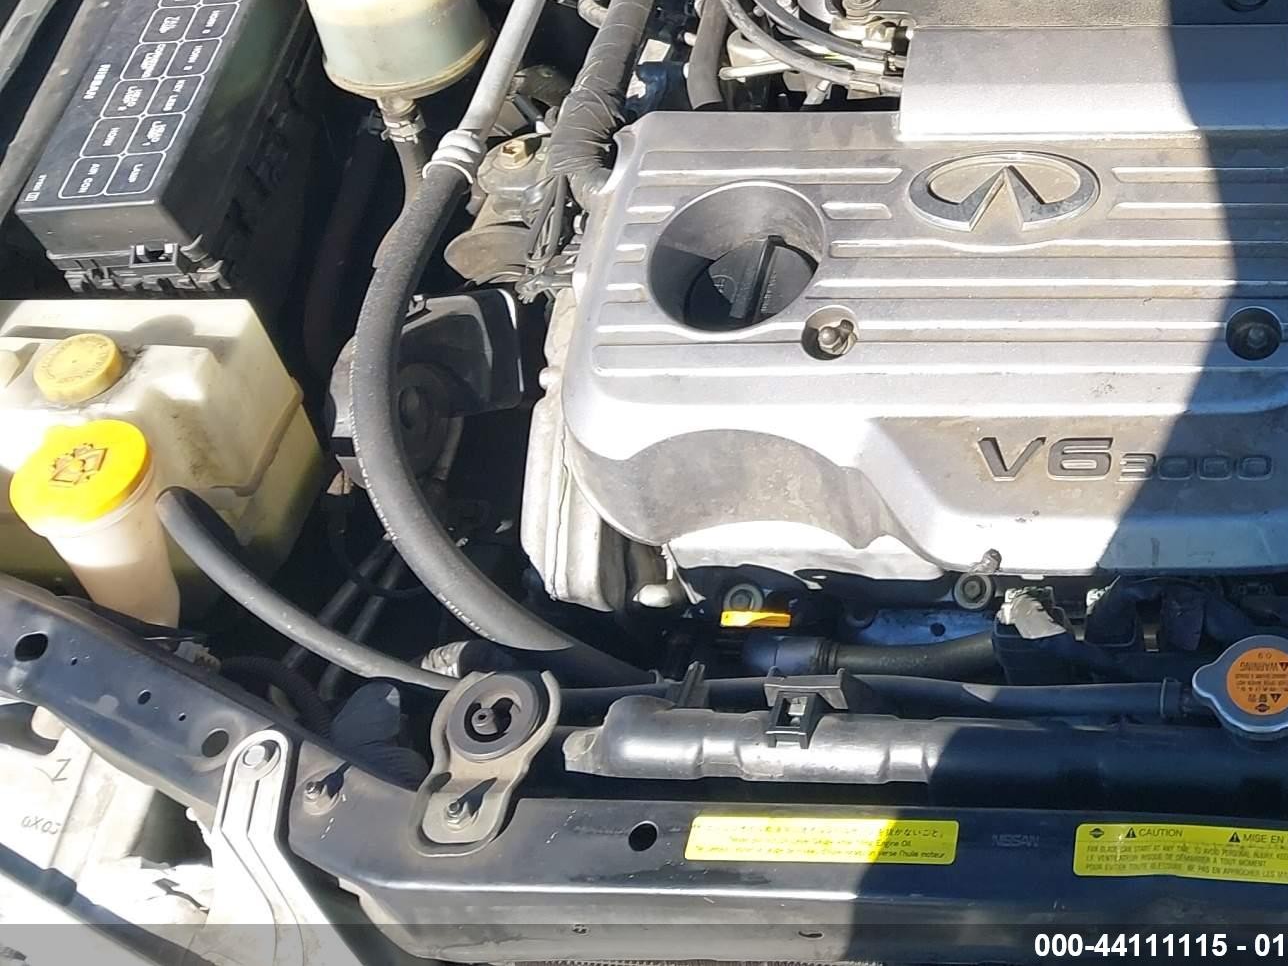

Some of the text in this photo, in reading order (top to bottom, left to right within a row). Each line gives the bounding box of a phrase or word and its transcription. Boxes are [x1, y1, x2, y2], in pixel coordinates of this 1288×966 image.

[82, 64, 112, 100] NISSAN
[128, 163, 144, 183] LAMP
[977, 436, 1114, 482] V6
[1116, 452, 1273, 483] 3000
[1240, 661, 1279, 671] WARNING
[1138, 828, 1184, 838] CAUTION
[1243, 833, 1268, 843] MISE
[1270, 835, 1284, 844] EN
